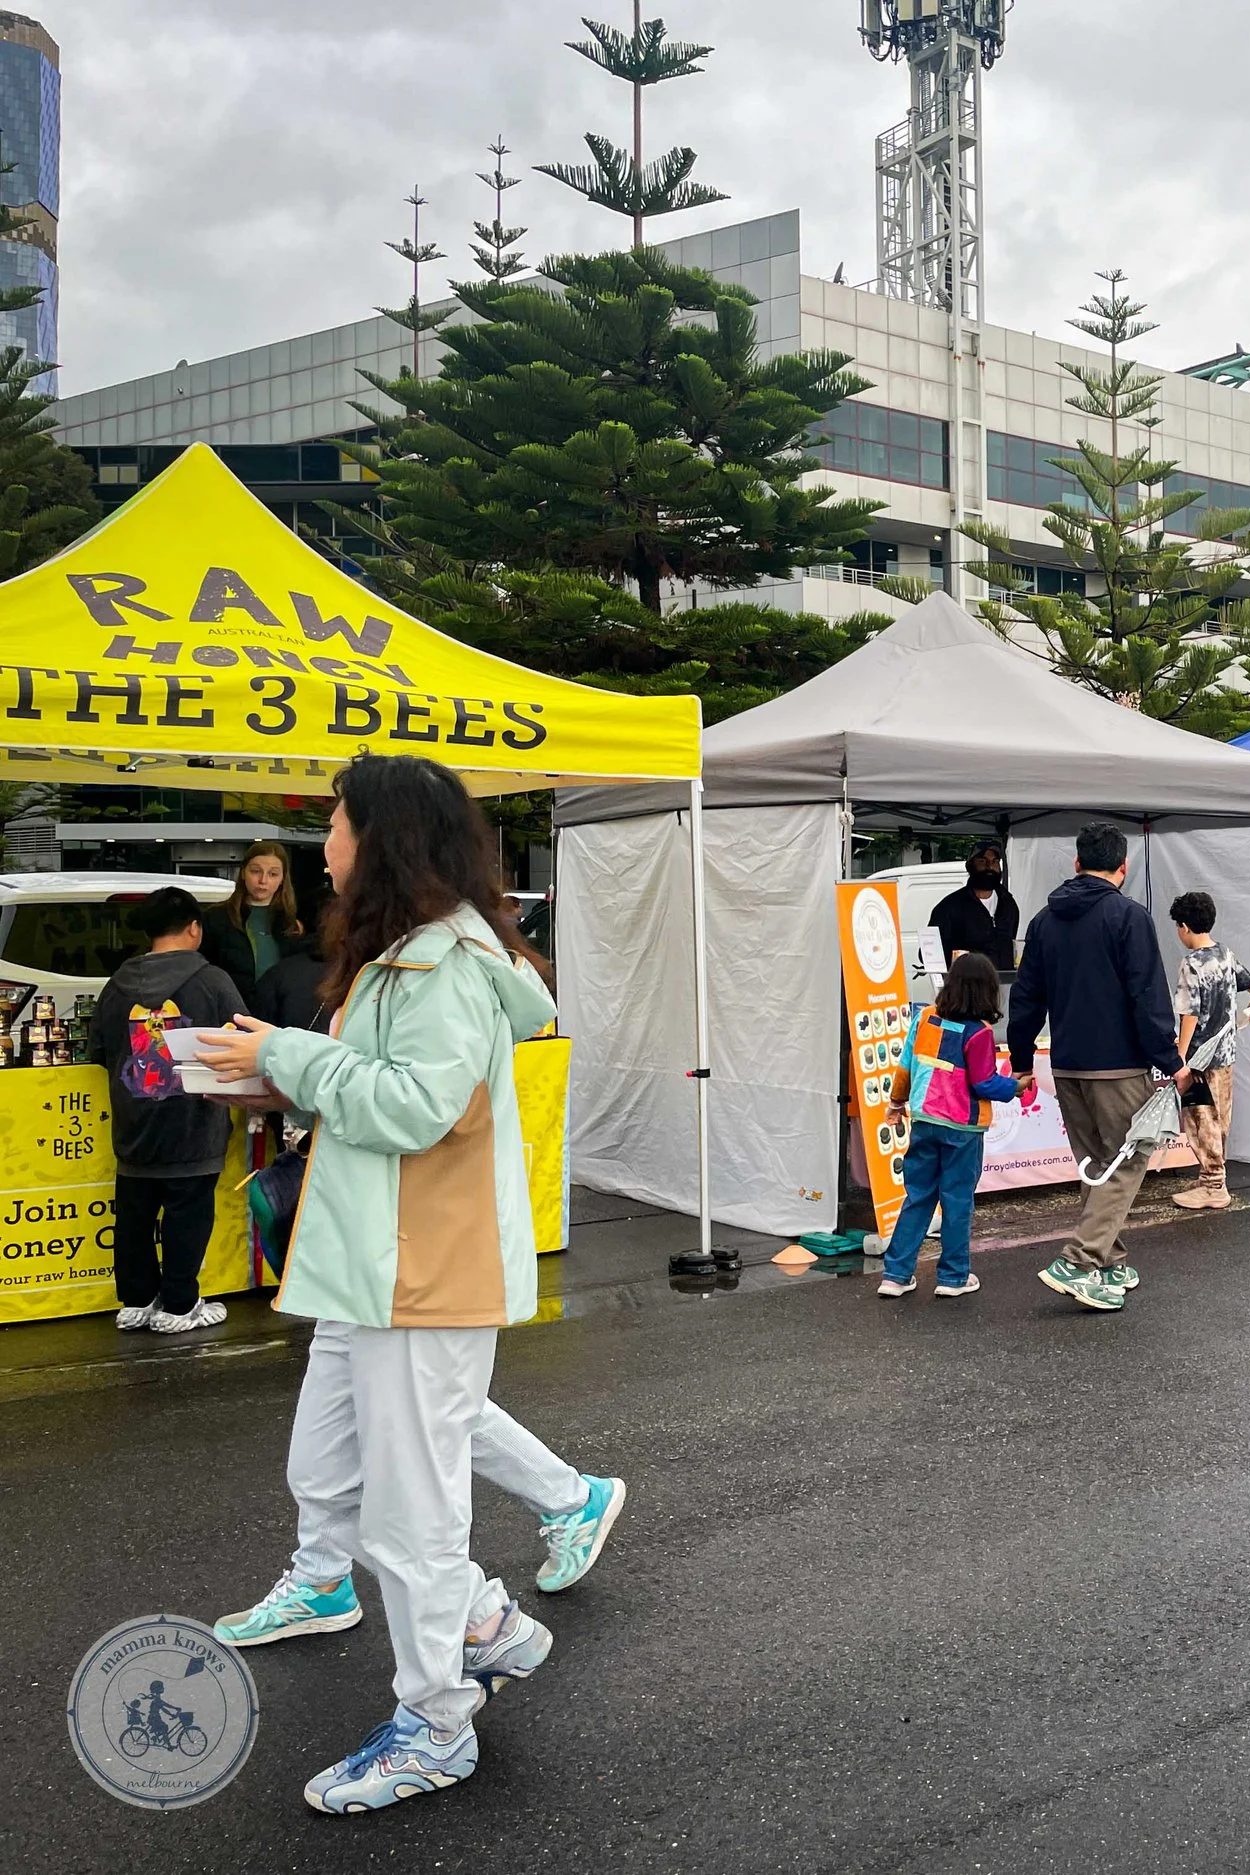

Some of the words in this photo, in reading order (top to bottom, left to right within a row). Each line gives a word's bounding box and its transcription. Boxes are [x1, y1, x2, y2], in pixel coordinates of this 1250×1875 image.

[65, 566, 393, 657] RAW
[208, 627, 306, 647] AUSTRALIAN
[0, 665, 215, 728] THE
[246, 675, 297, 735] 3
[327, 681, 548, 749] BEES
[59, 1092, 91, 1113] THE
[53, 1136, 94, 1160] BEES
[4, 1198, 78, 1225] Join
[0, 1235, 86, 1260] oney
[35, 1271, 65, 1283] raw
[69, 1265, 115, 1279] honey
